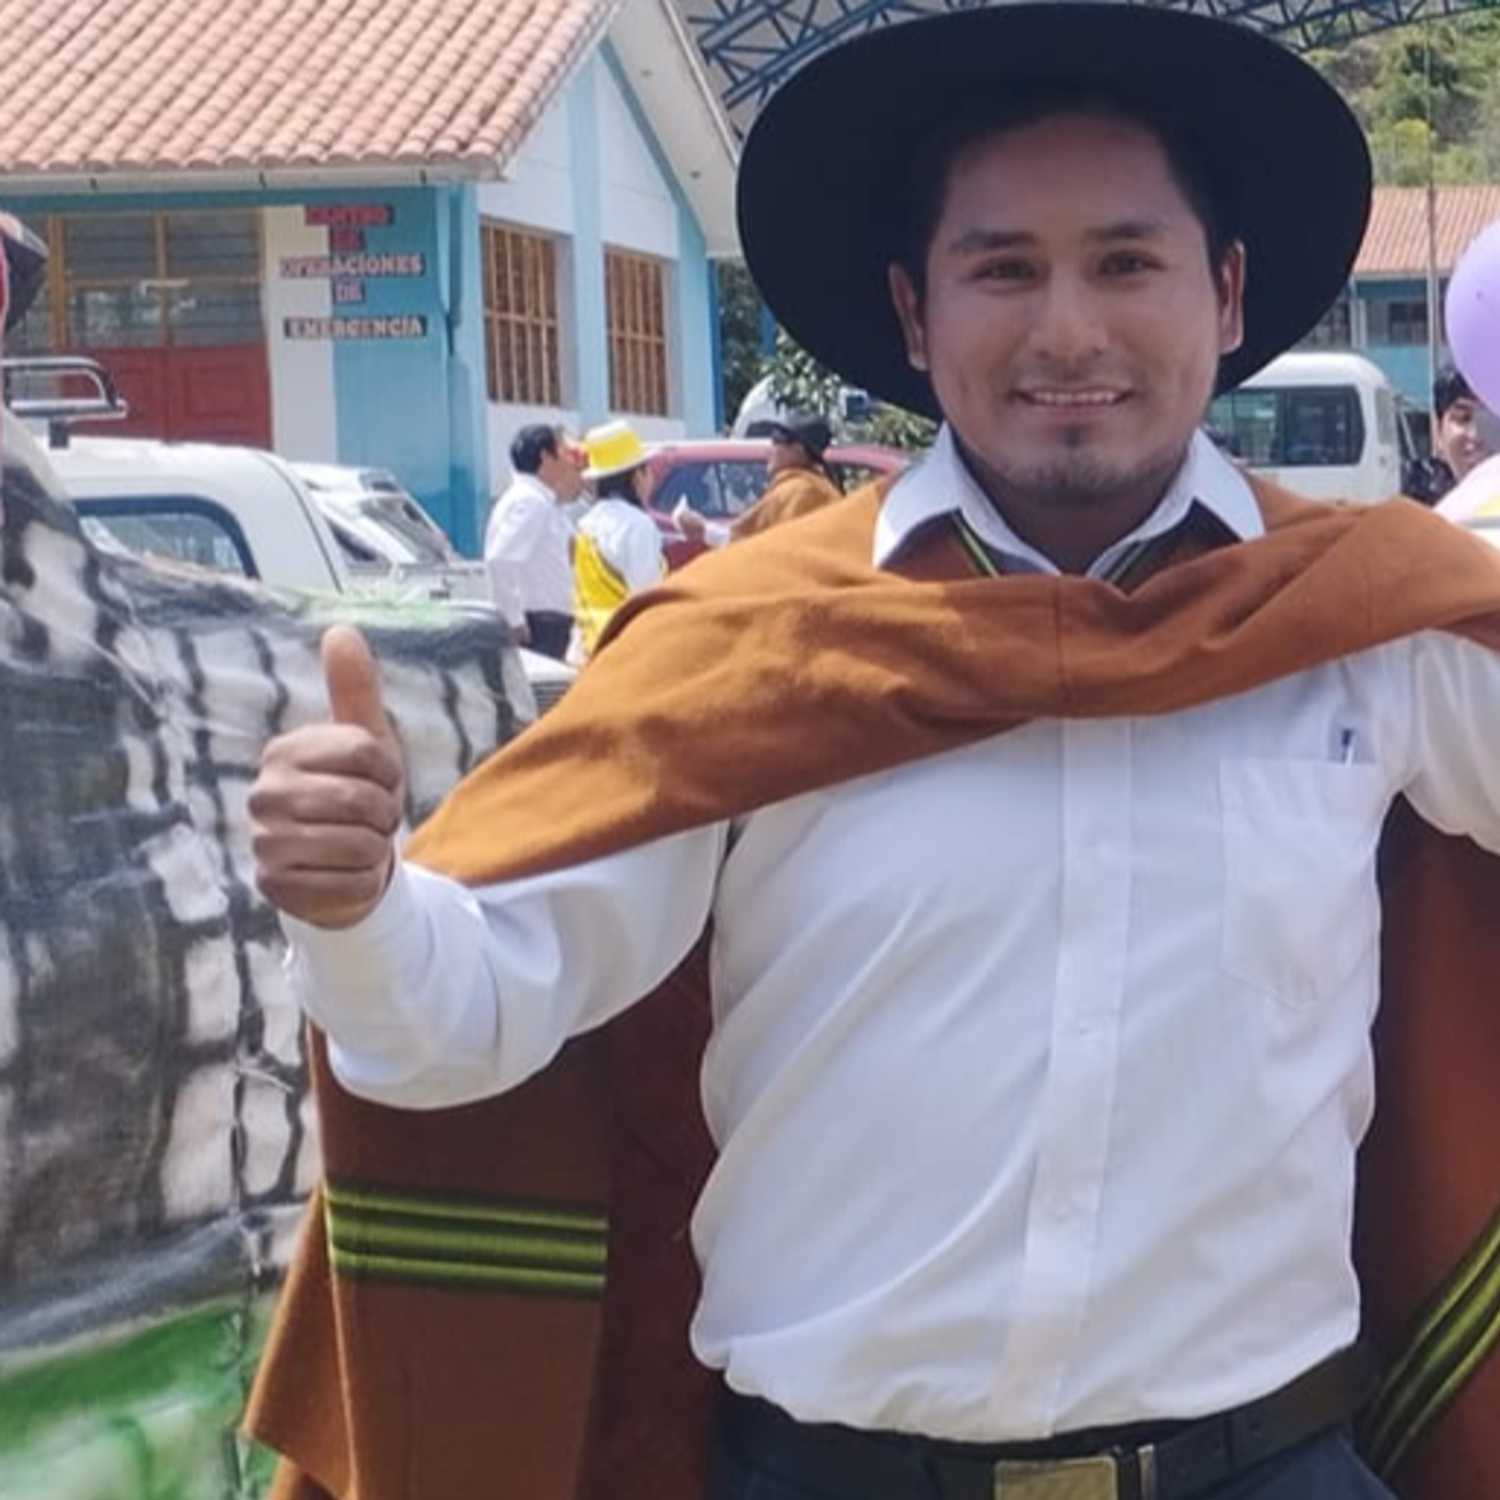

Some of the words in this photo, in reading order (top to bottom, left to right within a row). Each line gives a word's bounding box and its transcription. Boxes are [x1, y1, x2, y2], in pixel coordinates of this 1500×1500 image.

[281, 252, 423, 276] OPERACIONES
[335, 283, 363, 302] DE
[287, 317, 423, 338] EMERGENCIA
